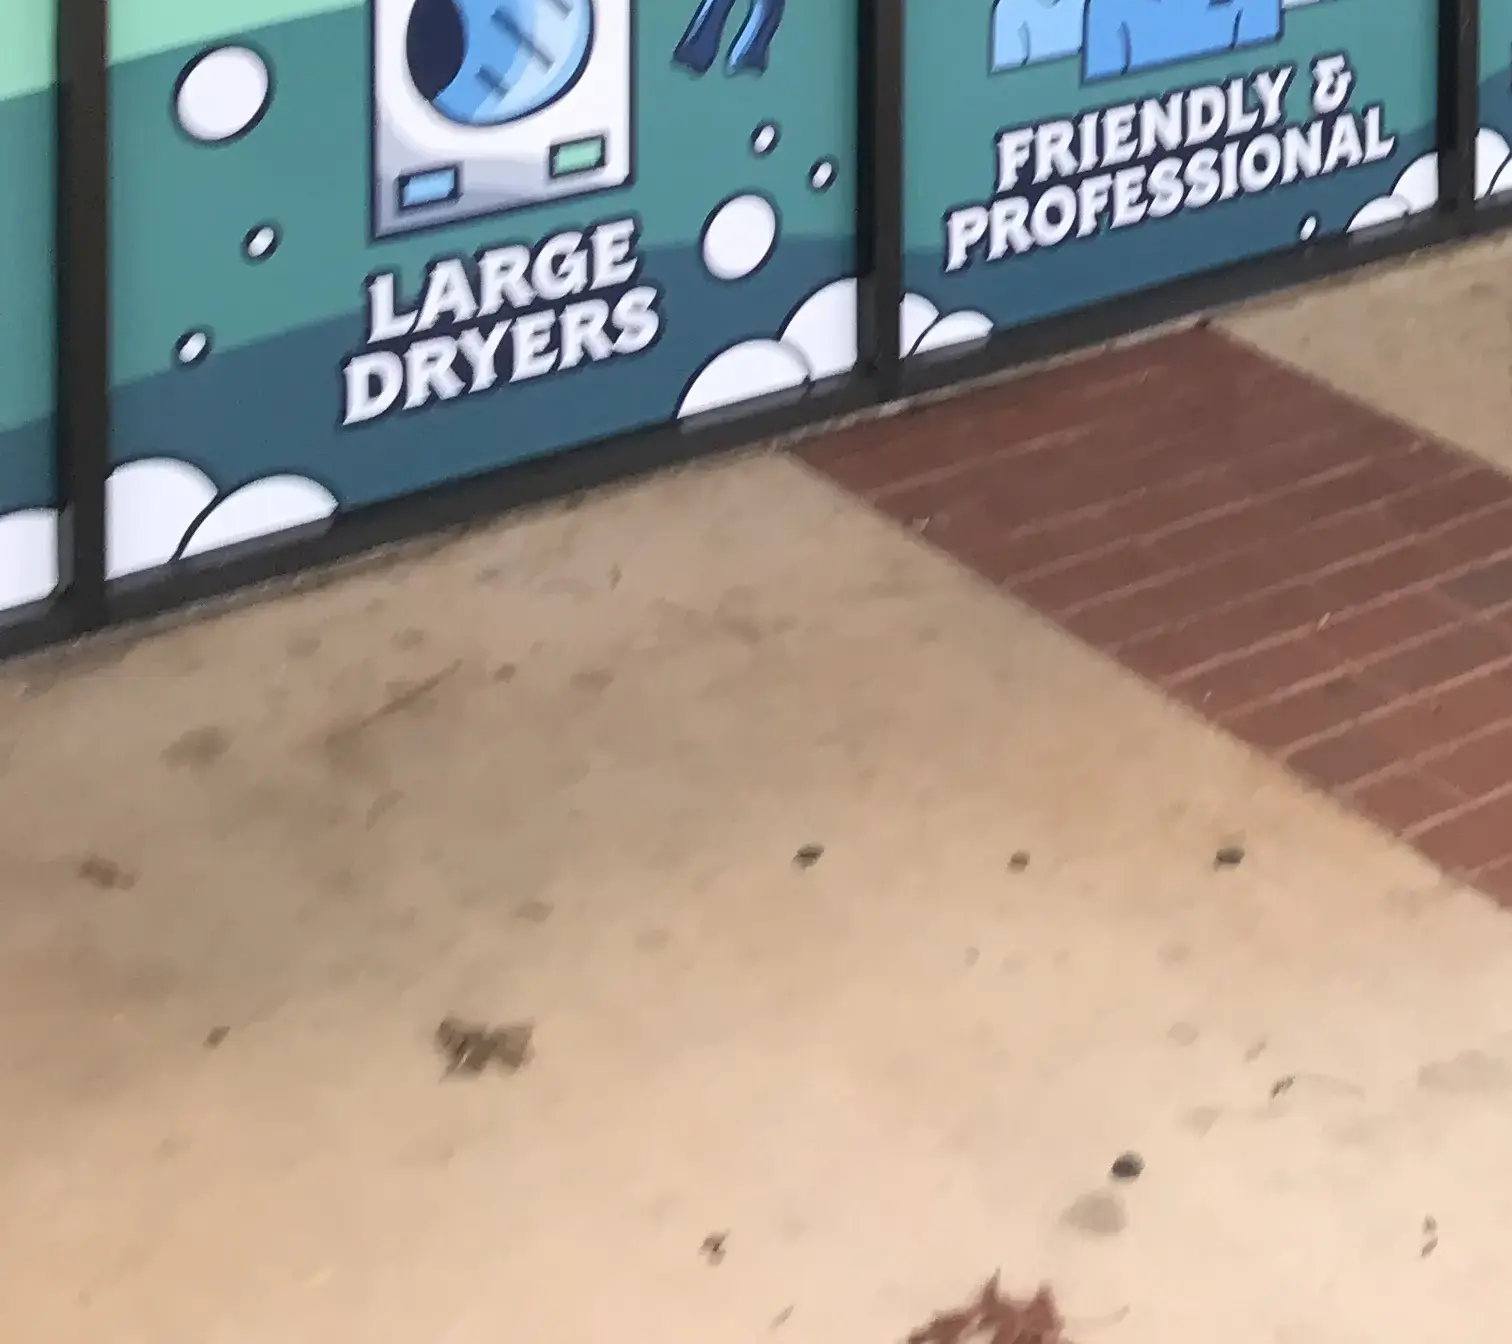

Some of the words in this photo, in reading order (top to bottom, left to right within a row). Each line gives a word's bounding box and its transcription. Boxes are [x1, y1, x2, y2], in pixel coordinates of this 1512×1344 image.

[944, 105, 1396, 272] PROFESSIONAL
[996, 67, 1295, 193] FRIENDLY
[1310, 53, 1353, 114] &
[366, 219, 638, 344] LARGE
[341, 286, 661, 426] DRYERS
